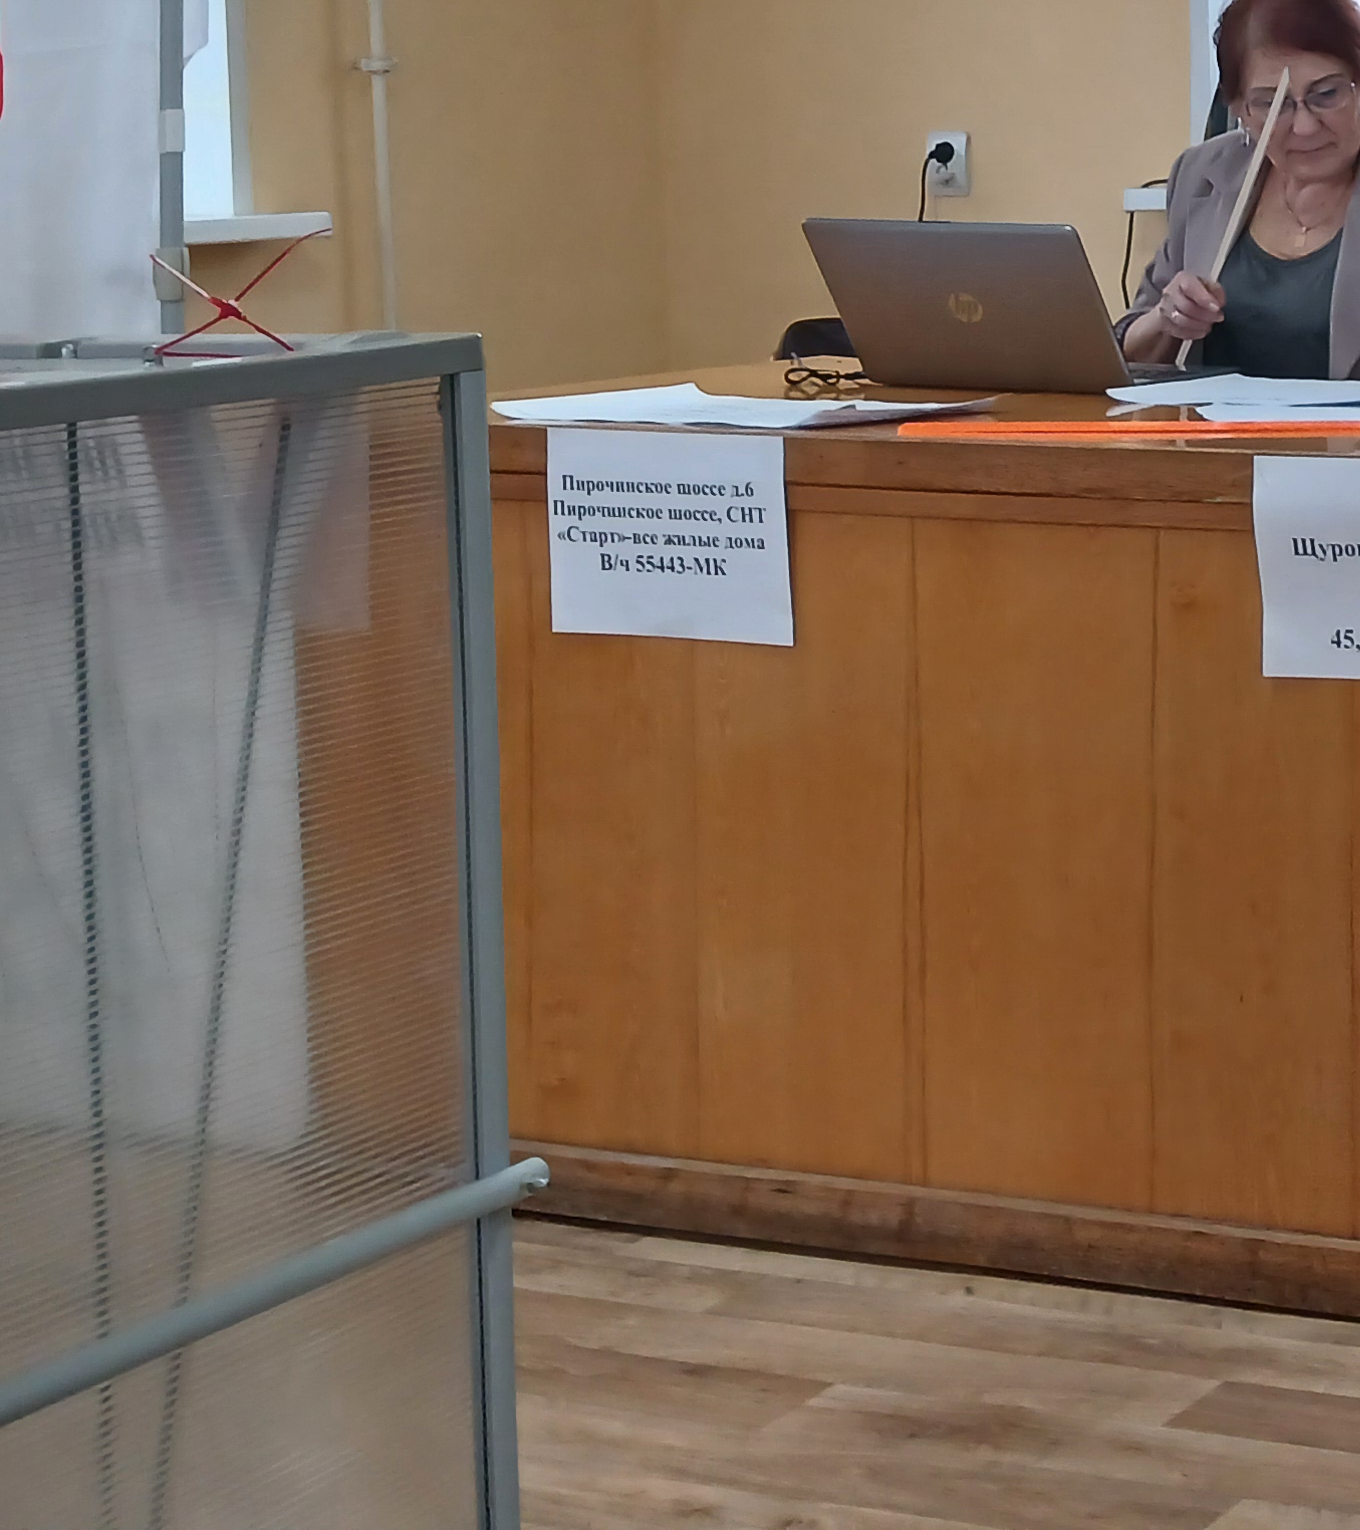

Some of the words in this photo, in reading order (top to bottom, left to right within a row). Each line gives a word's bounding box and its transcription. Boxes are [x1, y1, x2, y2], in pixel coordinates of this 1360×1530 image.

[562, 474, 672, 496] Пирочинское
[677, 482, 726, 496] шоссе
[731, 482, 754, 498] д.6
[553, 500, 663, 520] Пирочинское
[668, 508, 722, 523] шоссе,
[726, 506, 766, 523] СНТ
[664, 533, 720, 548] жилые
[725, 537, 765, 549] дома
[600, 554, 630, 572] В/ч
[635, 555, 726, 575] 55443-МК
[1330, 629, 1360, 652] 45,
